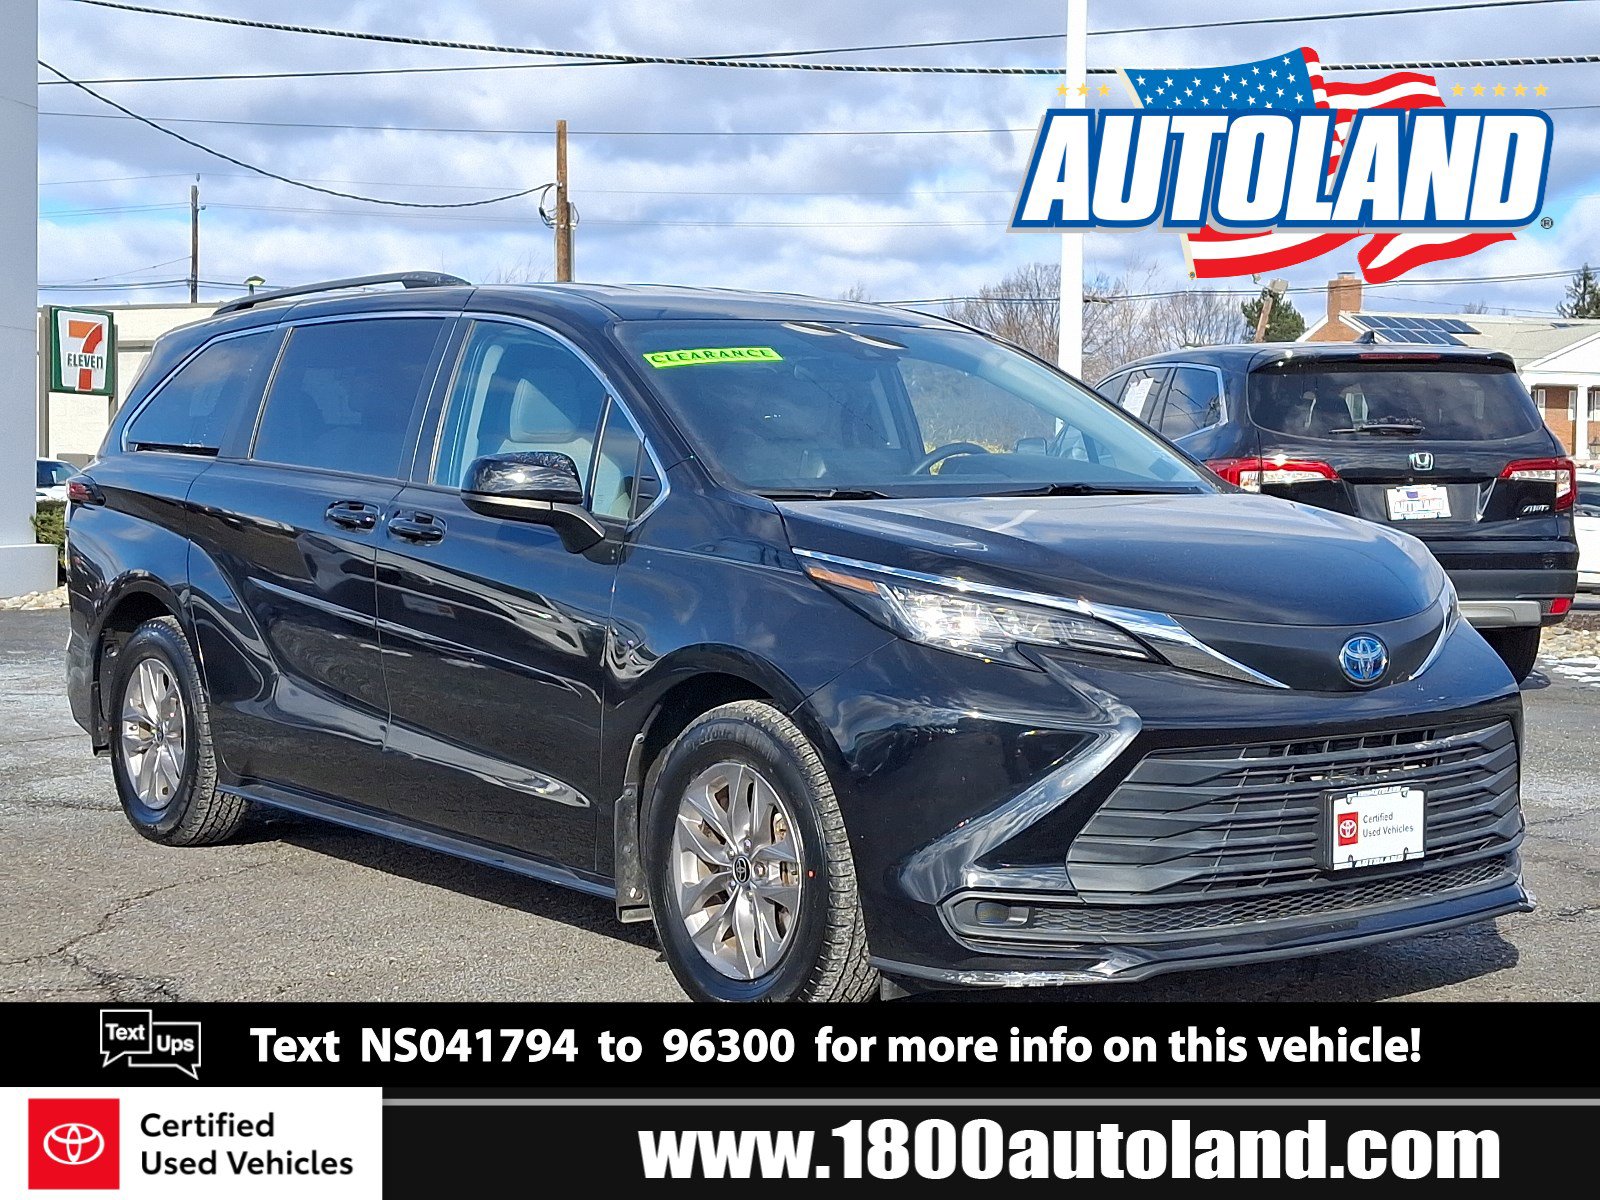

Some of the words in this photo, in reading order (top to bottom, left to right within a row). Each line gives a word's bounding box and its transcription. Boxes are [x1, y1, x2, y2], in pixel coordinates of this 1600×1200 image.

[68, 320, 103, 391] 7
[650, 348, 773, 363] CLEARANCE
[1362, 811, 1394, 824] Certified
[1362, 827, 1381, 838] Used
[1383, 824, 1414, 836] Vehicles
